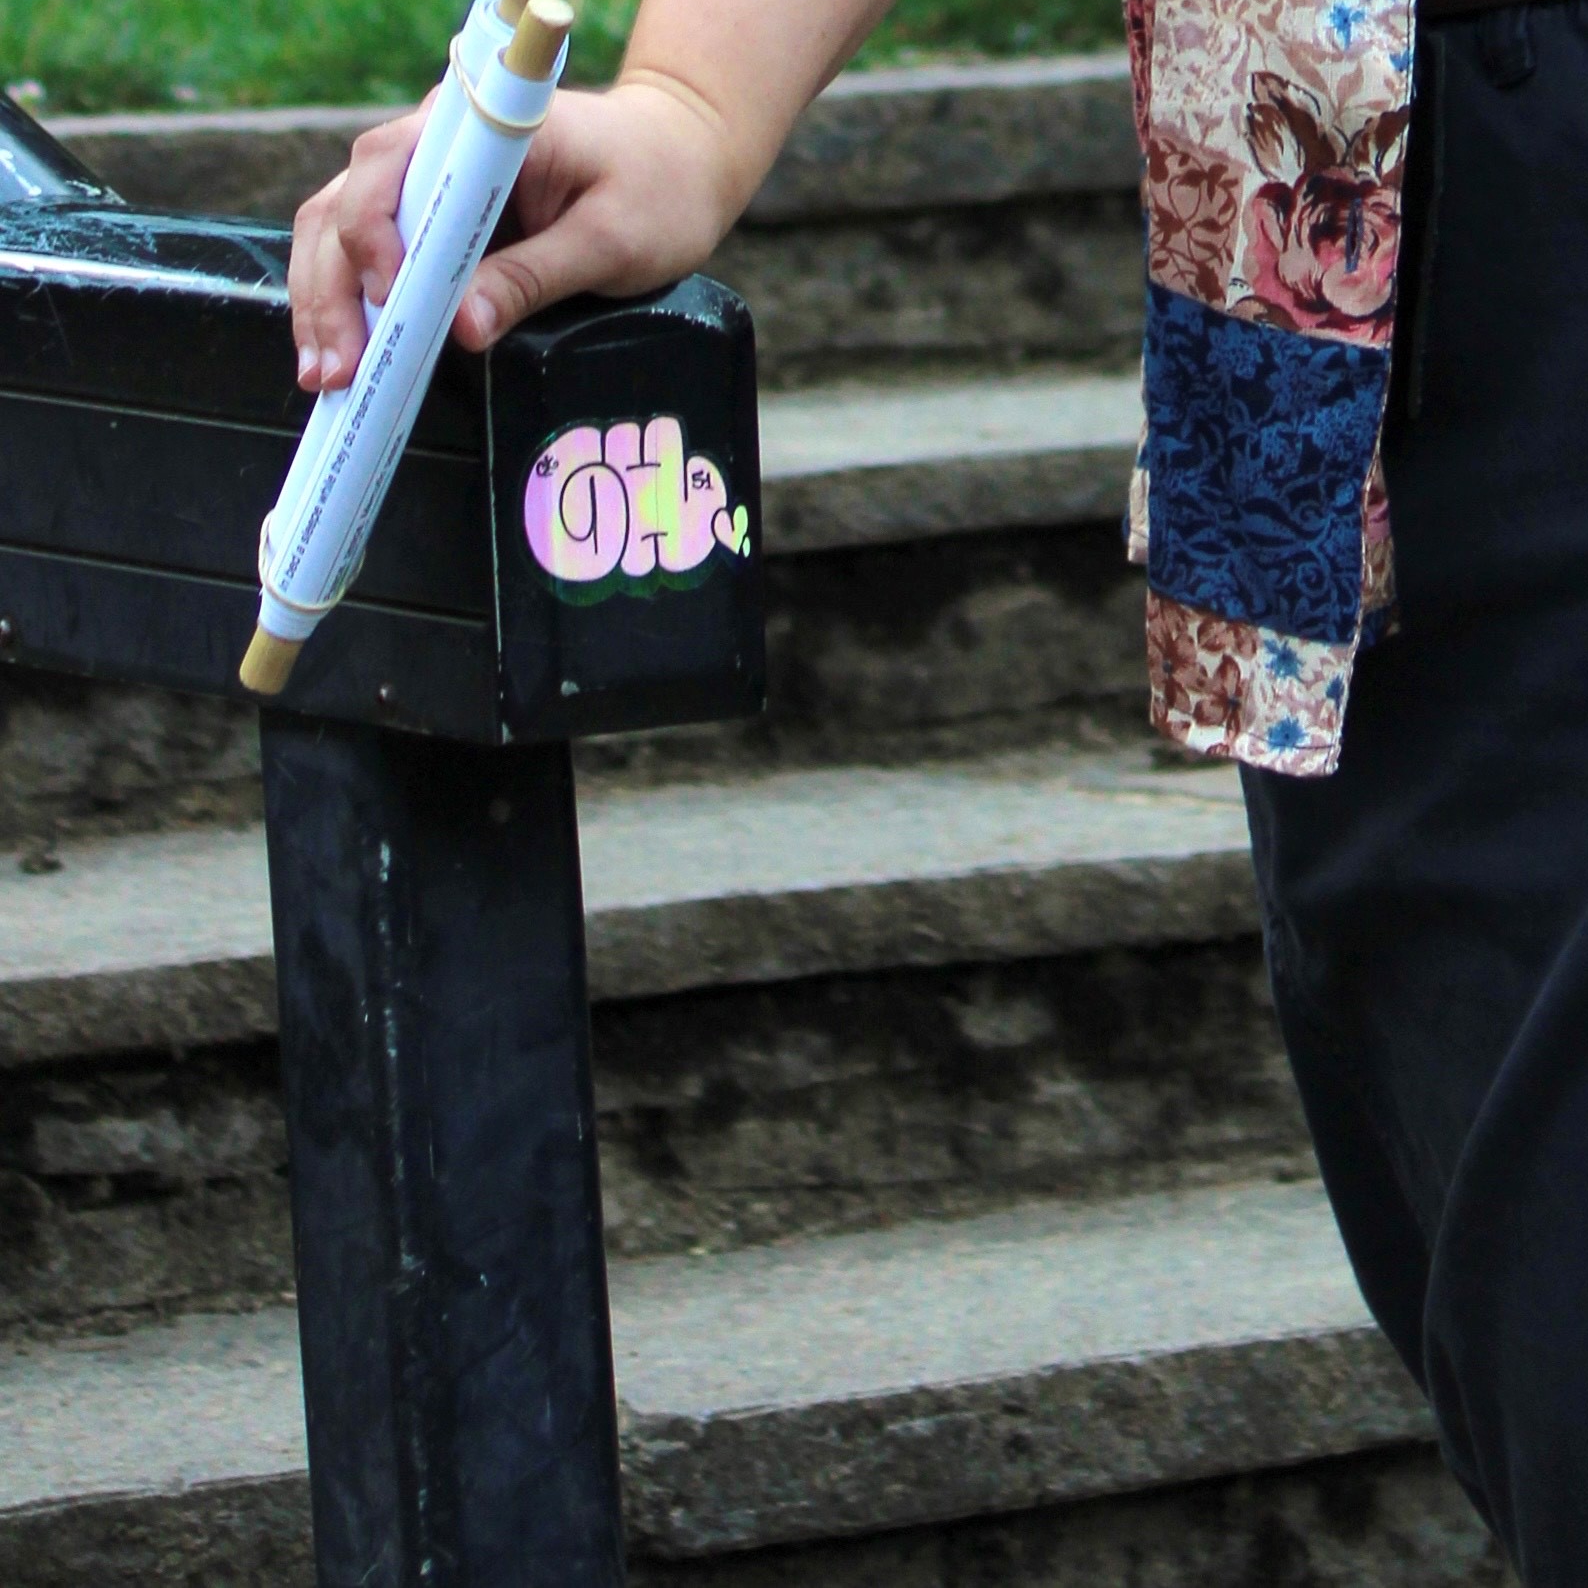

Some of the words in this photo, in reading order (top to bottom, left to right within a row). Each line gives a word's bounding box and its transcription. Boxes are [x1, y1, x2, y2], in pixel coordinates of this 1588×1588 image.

[285, 554, 301, 580] bed
[296, 543, 306, 555] a
[301, 504, 323, 545] sleepe
[320, 473, 337, 504] while
[331, 446, 351, 475] they
[343, 430, 356, 448] do
[352, 384, 376, 431] dreame
[370, 347, 394, 385] things
